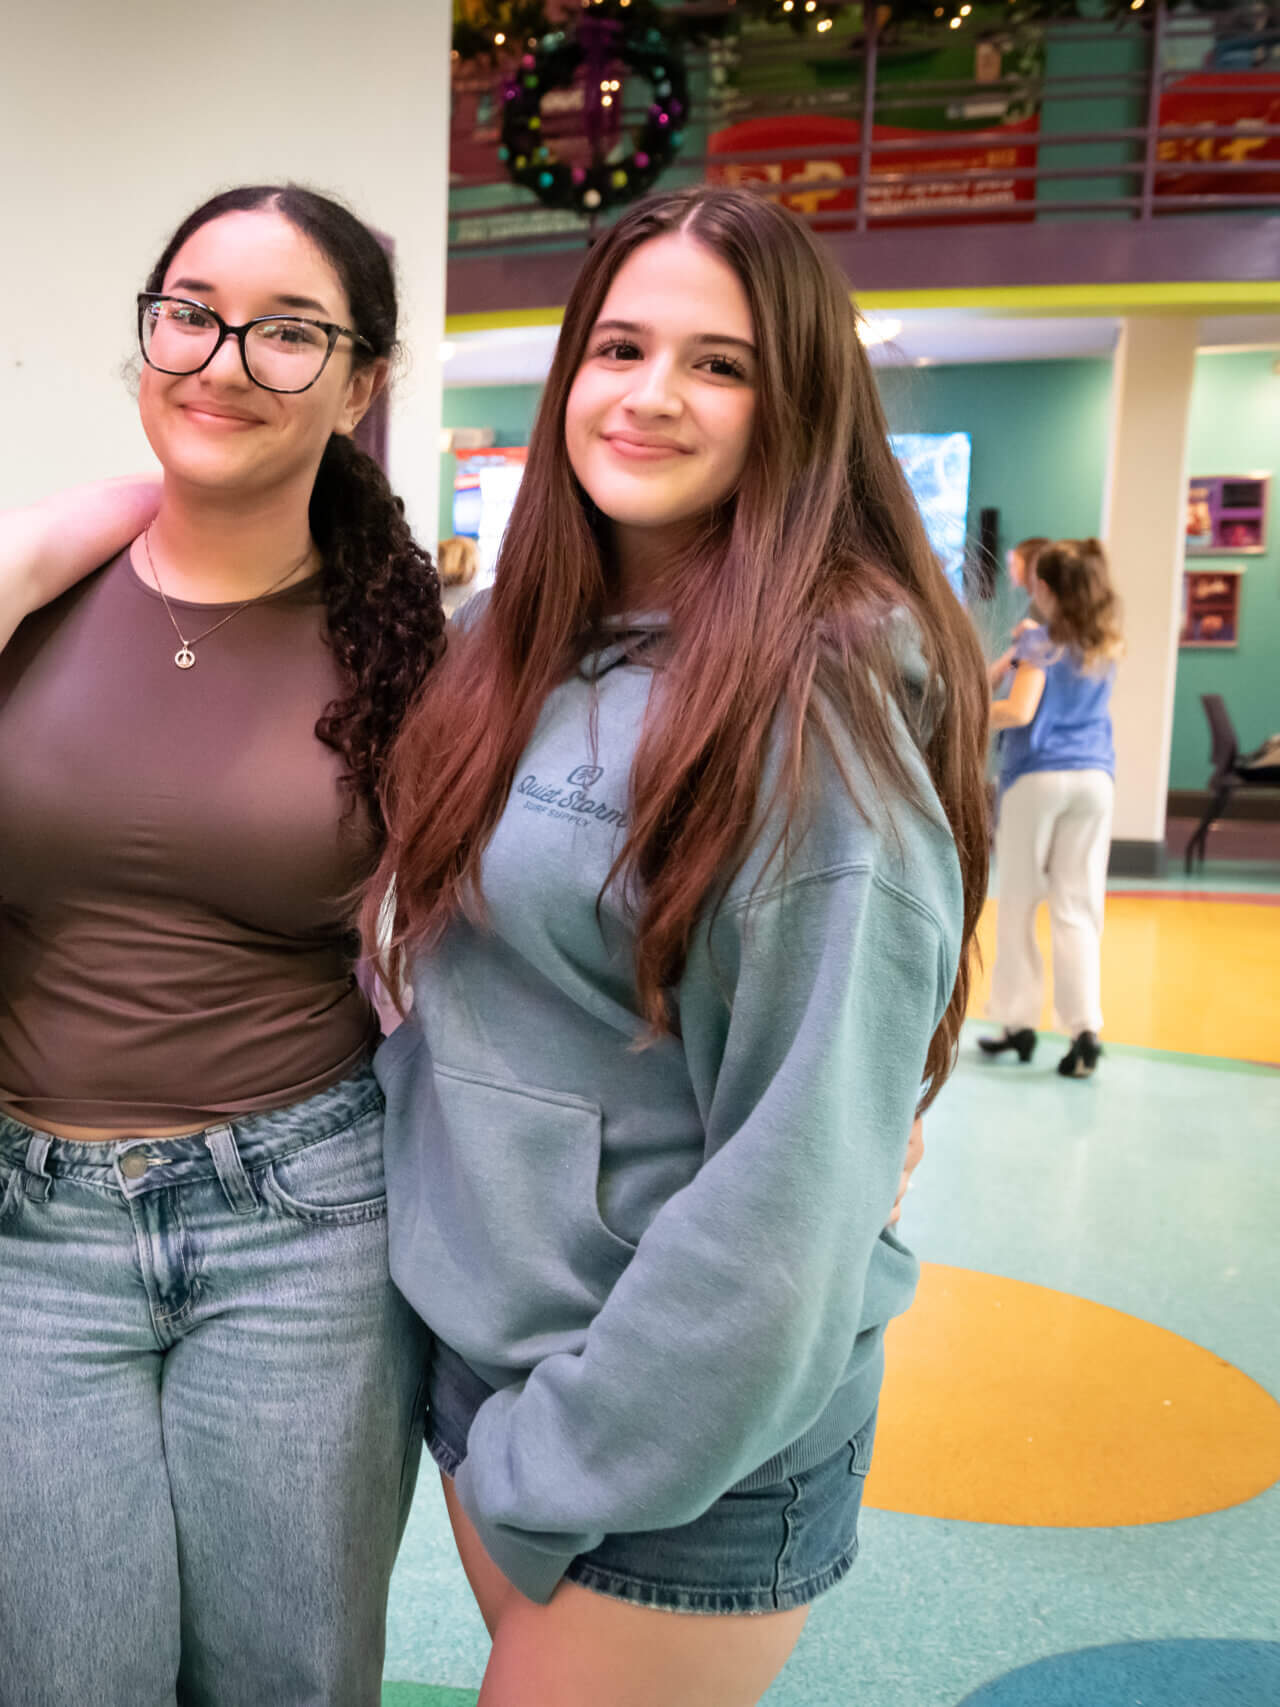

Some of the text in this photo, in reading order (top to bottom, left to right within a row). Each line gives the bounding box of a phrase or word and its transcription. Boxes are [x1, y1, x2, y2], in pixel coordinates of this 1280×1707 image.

[517, 775, 628, 828] Quiet Storm
[547, 808, 592, 826] SUPPLY
